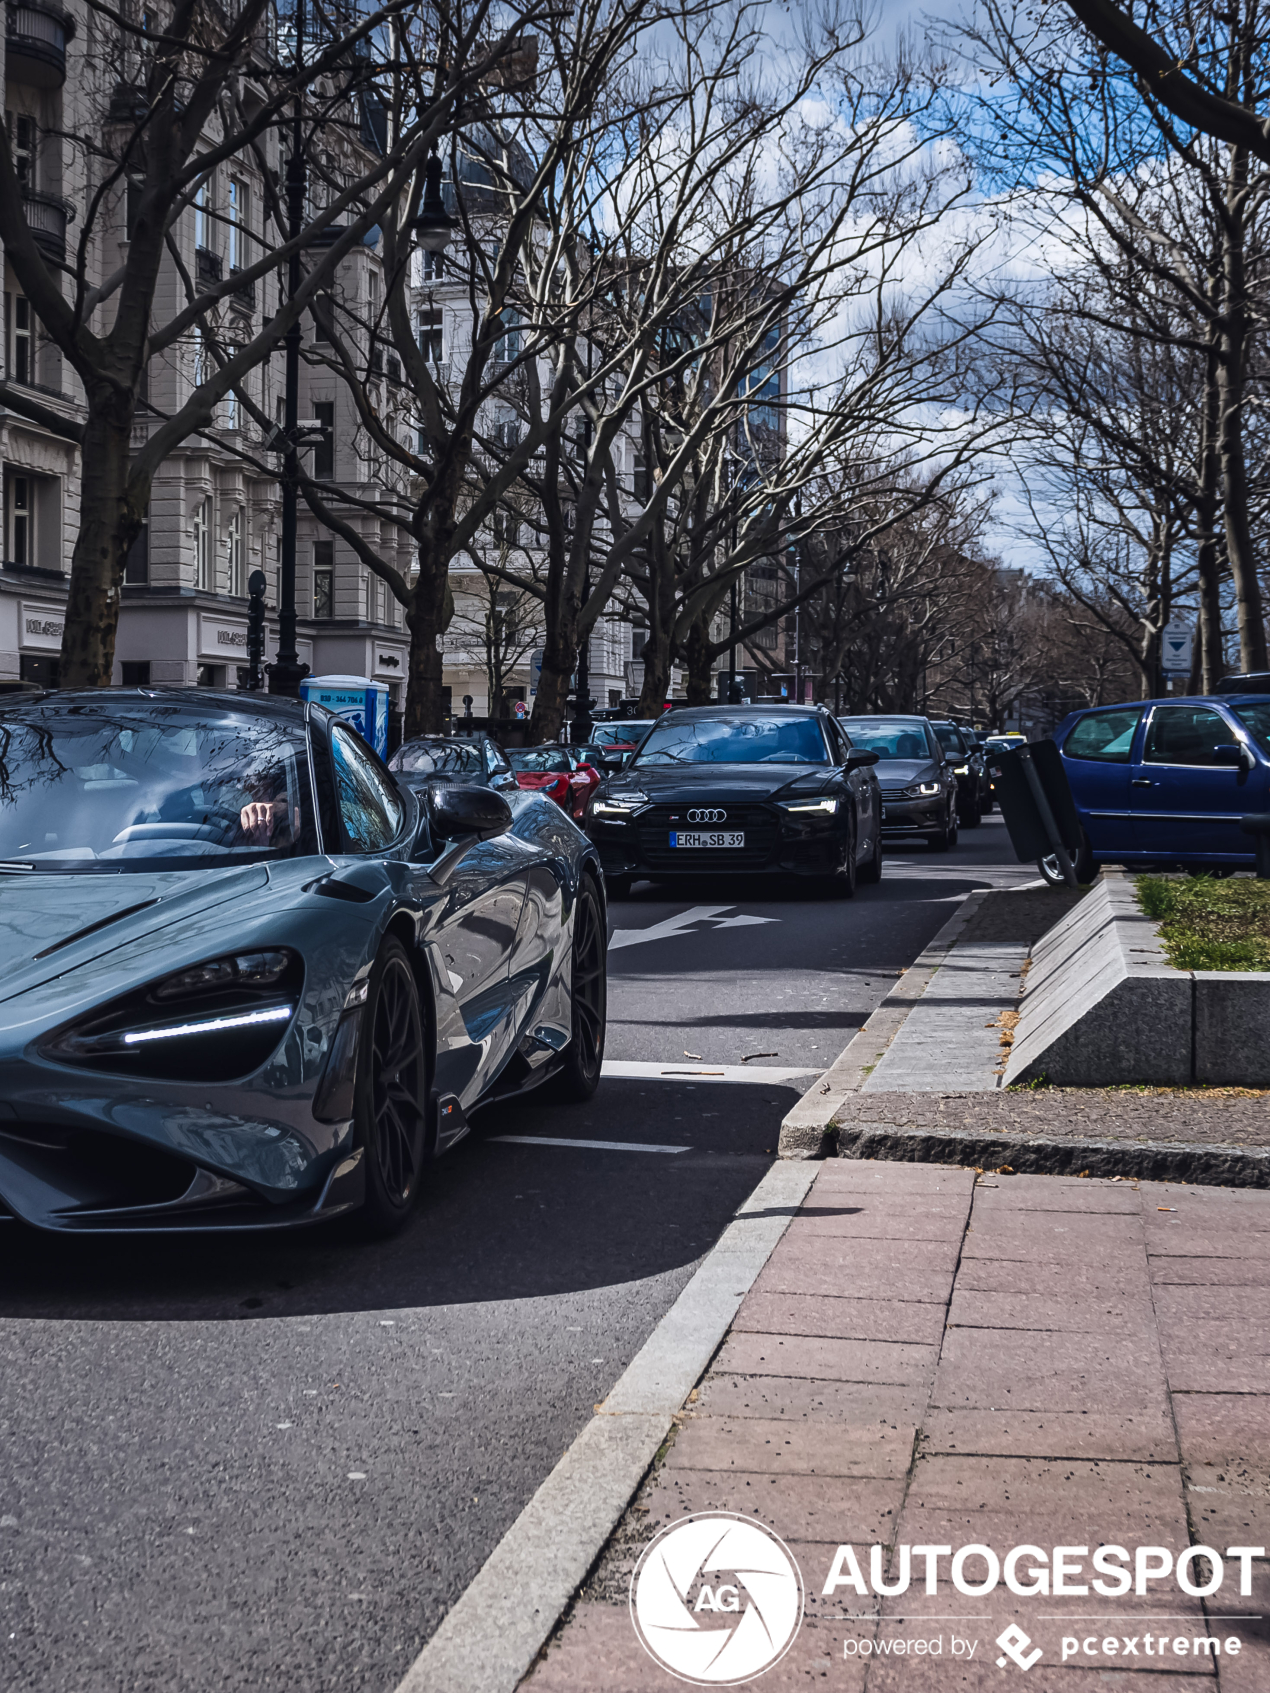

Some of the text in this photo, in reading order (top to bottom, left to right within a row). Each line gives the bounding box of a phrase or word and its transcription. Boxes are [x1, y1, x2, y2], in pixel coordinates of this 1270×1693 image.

[677, 834, 744, 846] ERH SB 39
